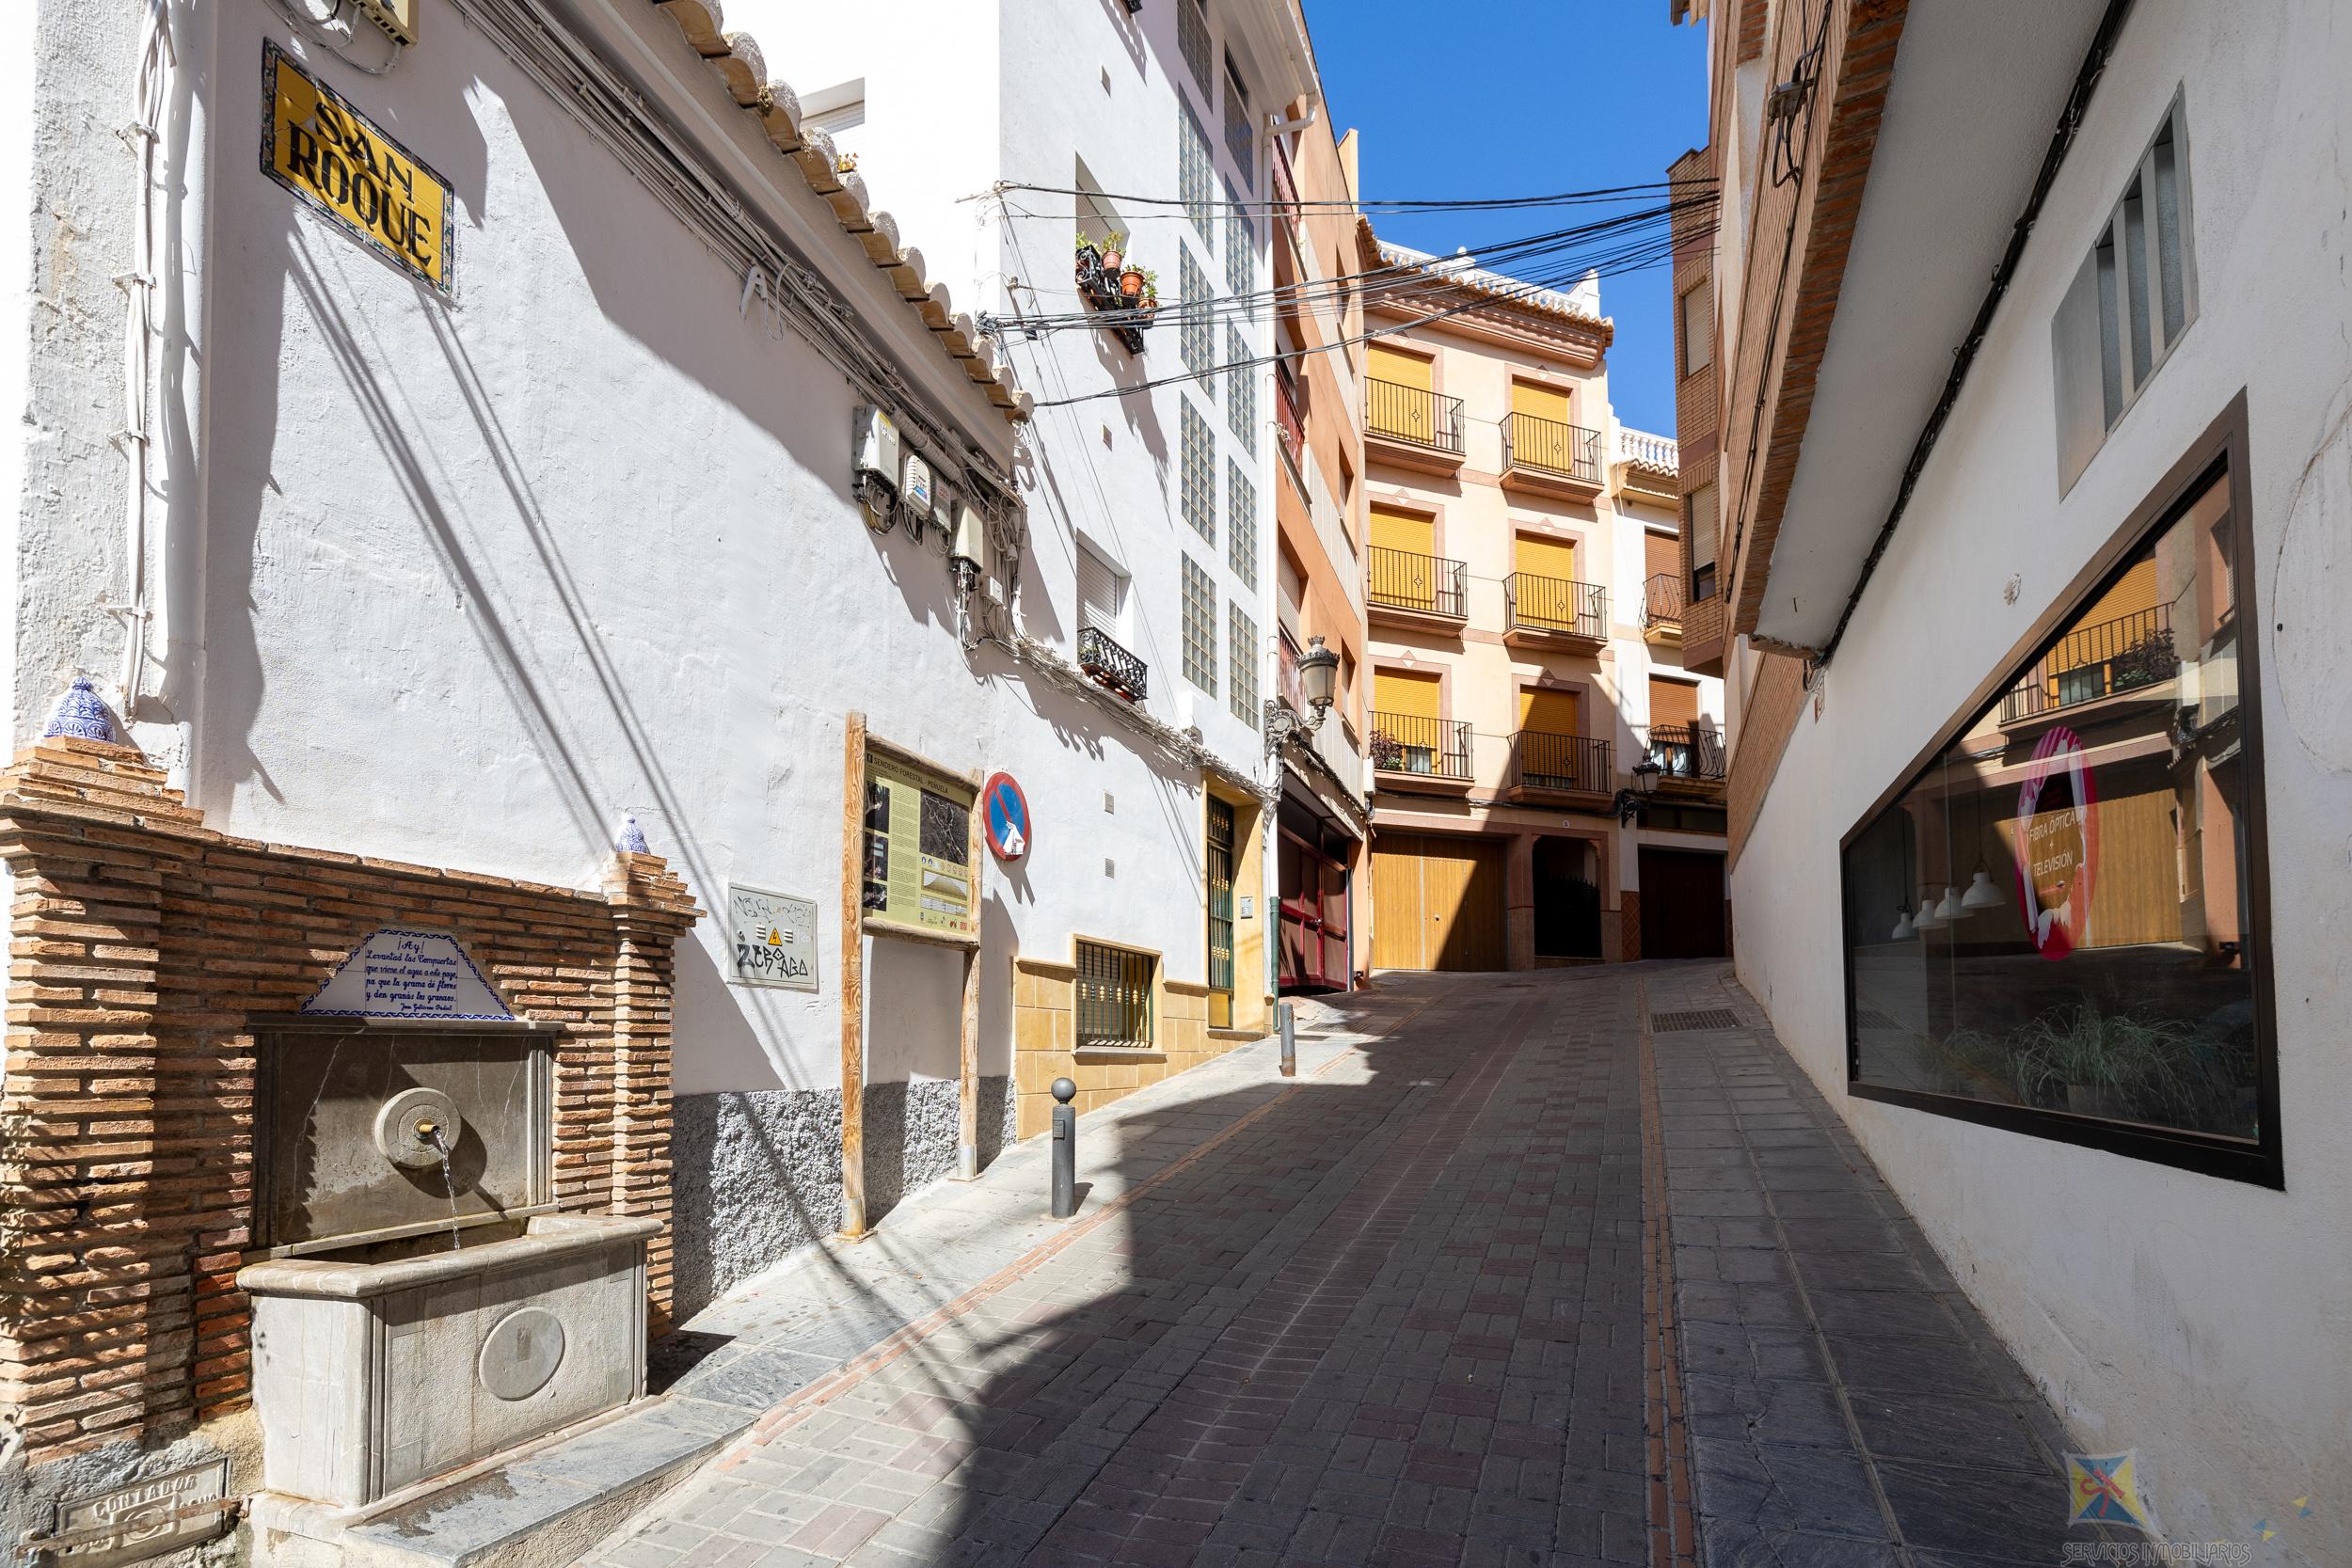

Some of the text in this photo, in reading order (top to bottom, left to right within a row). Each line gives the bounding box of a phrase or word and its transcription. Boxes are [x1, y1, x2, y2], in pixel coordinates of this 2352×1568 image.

[315, 102, 414, 204] SAN
[287, 119, 432, 267] ROQUE
[874, 757, 898, 773] SENDERO
[900, 768, 924, 784] FORESTAL
[2029, 811, 2075, 843] FIBRA ÓPTICA
[2033, 850, 2073, 878] TELEVISIÓN
[366, 965, 378, 975] que
[405, 953, 416, 962] las
[373, 990, 387, 998] den
[378, 979, 390, 989] que
[393, 977, 400, 986] la
[93, 1475, 197, 1518] CONTADOR
